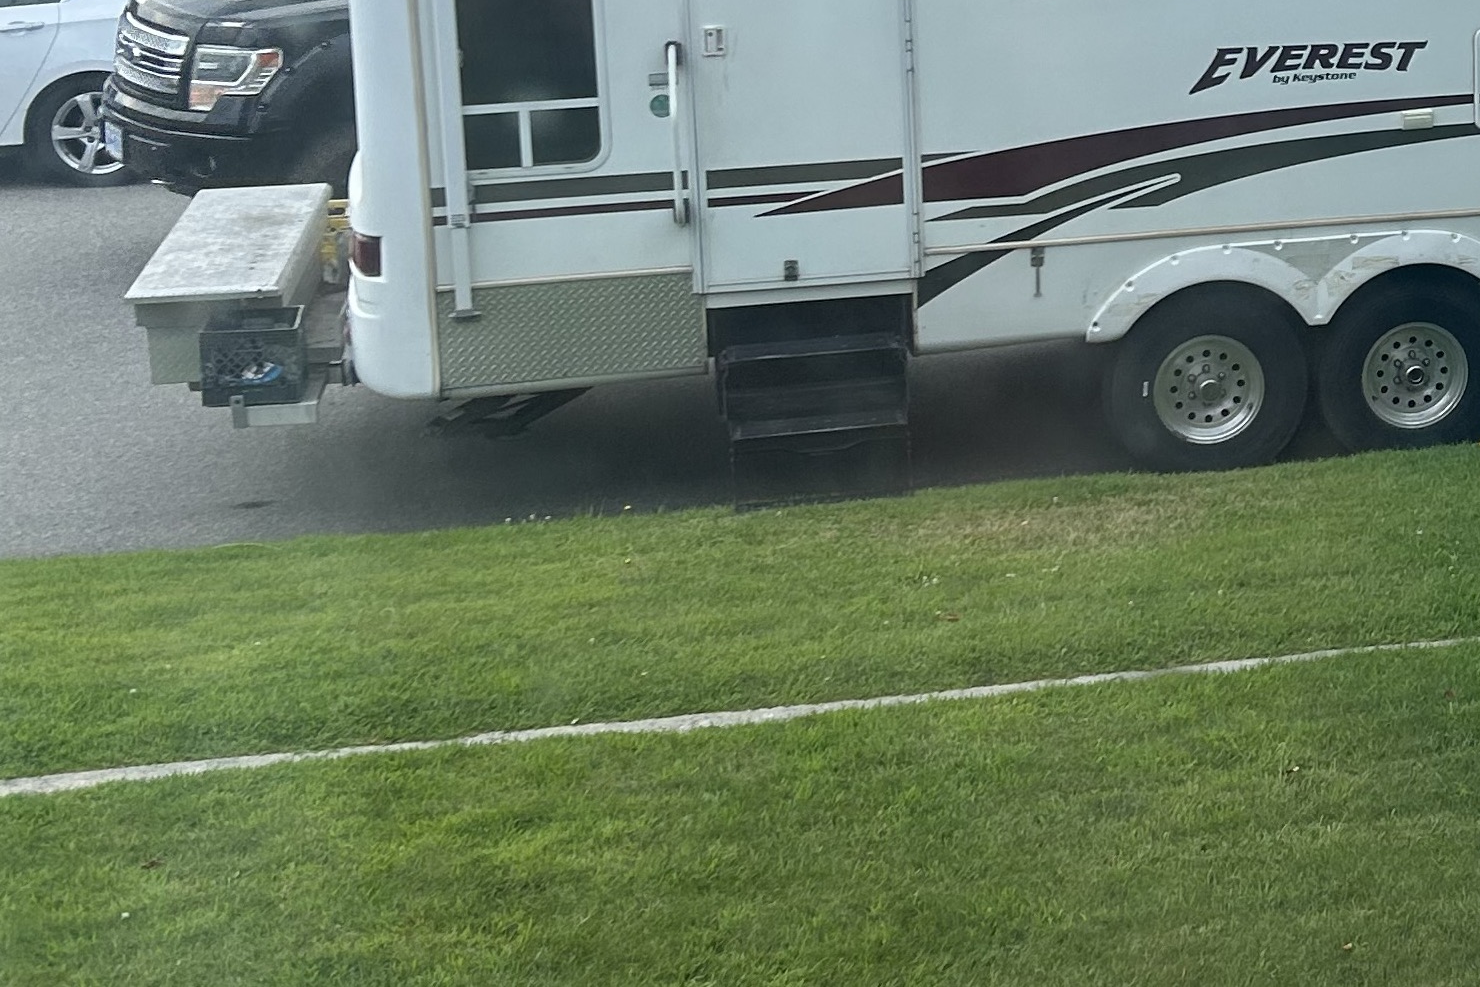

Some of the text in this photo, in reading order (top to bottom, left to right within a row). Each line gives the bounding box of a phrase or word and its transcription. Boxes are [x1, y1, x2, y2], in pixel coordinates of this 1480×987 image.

[1189, 40, 1428, 95] EVEREST
[1272, 72, 1357, 85] by Keystone
